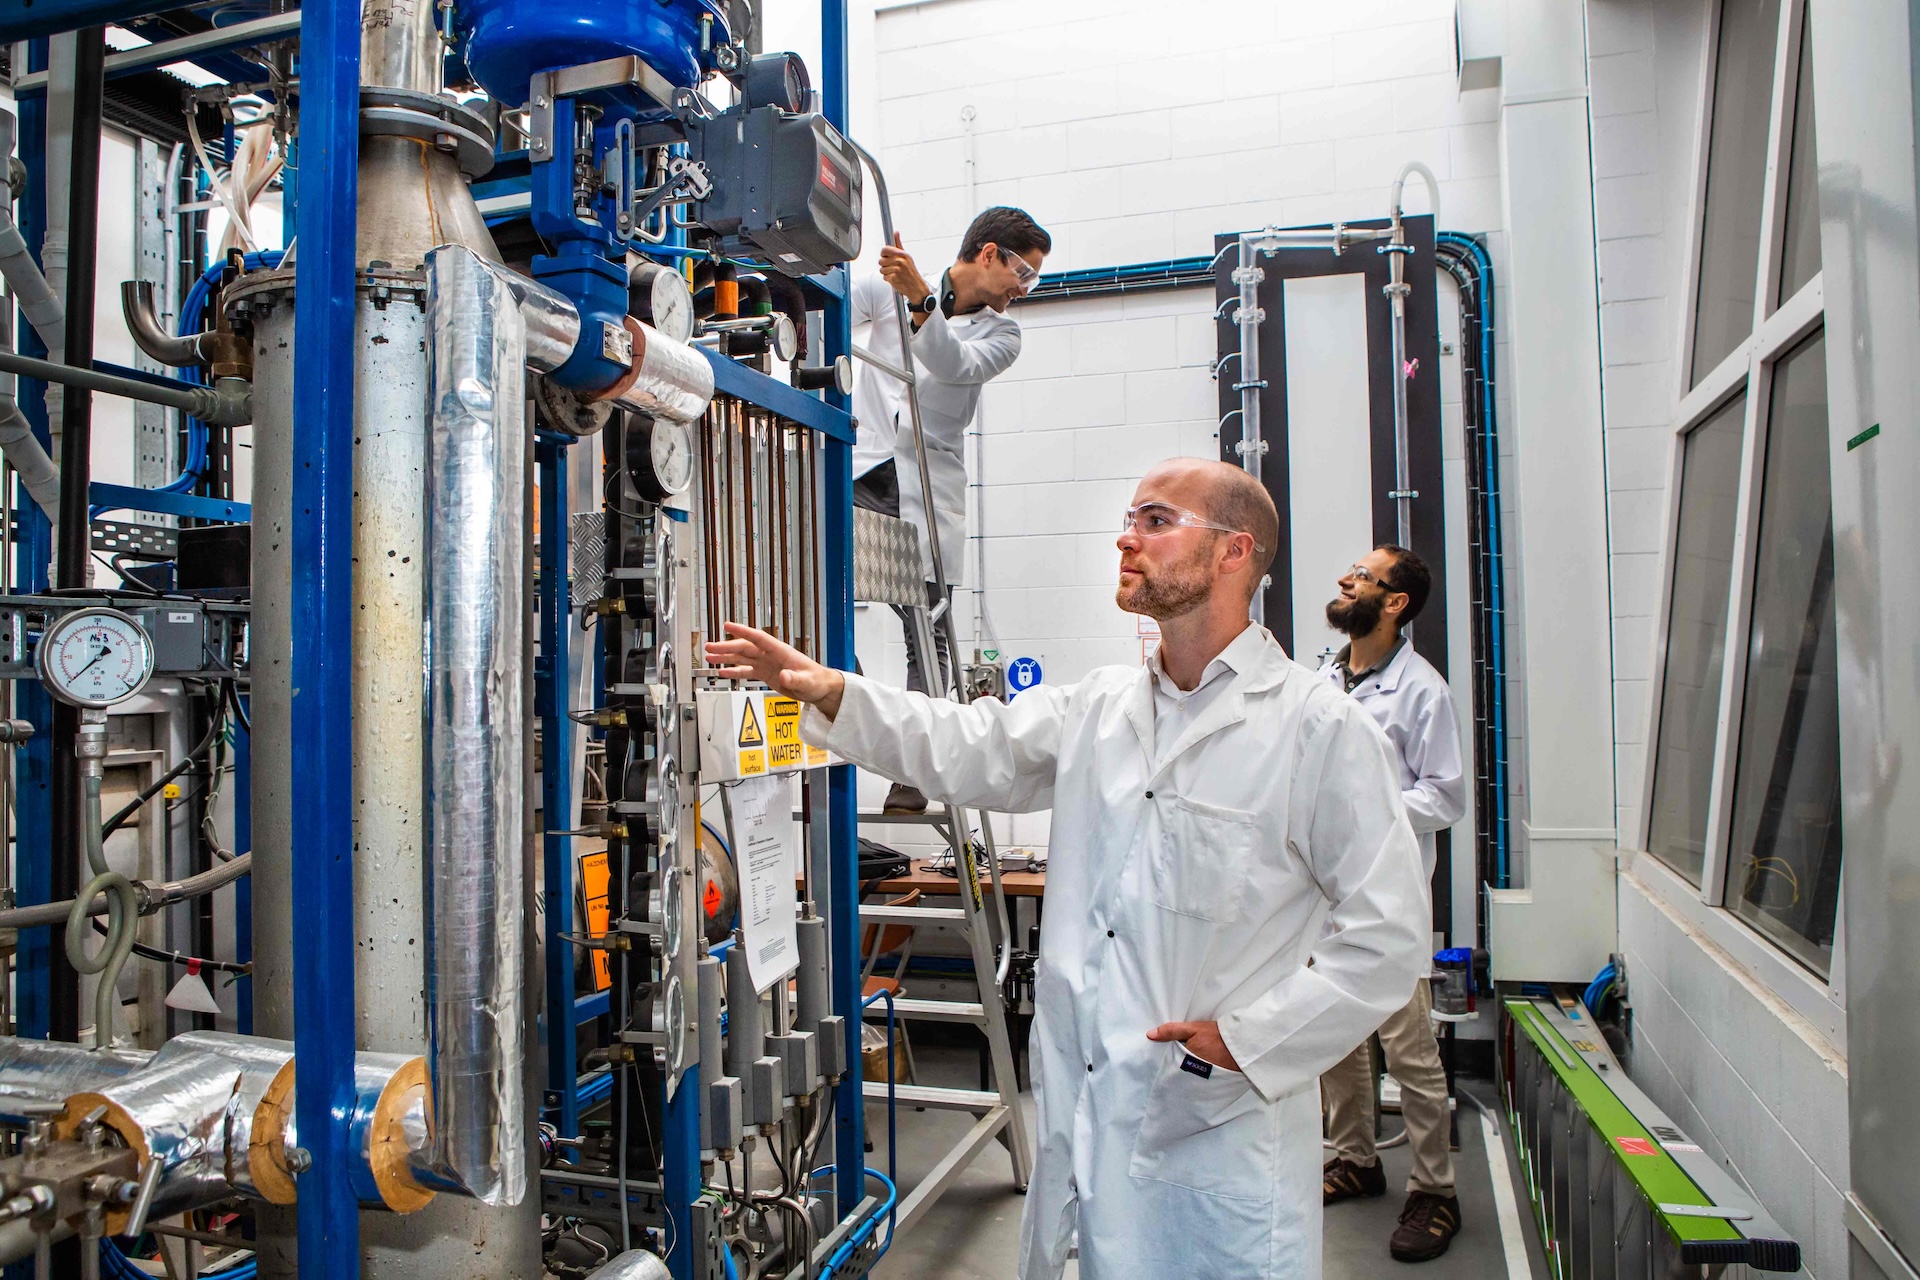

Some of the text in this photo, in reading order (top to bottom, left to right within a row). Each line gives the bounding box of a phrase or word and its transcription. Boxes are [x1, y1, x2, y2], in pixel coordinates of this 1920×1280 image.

[776, 703, 798, 714] WARNING
[775, 722, 793, 739] HOT
[771, 743, 801, 762] WATER
[744, 765, 761, 774] surface
